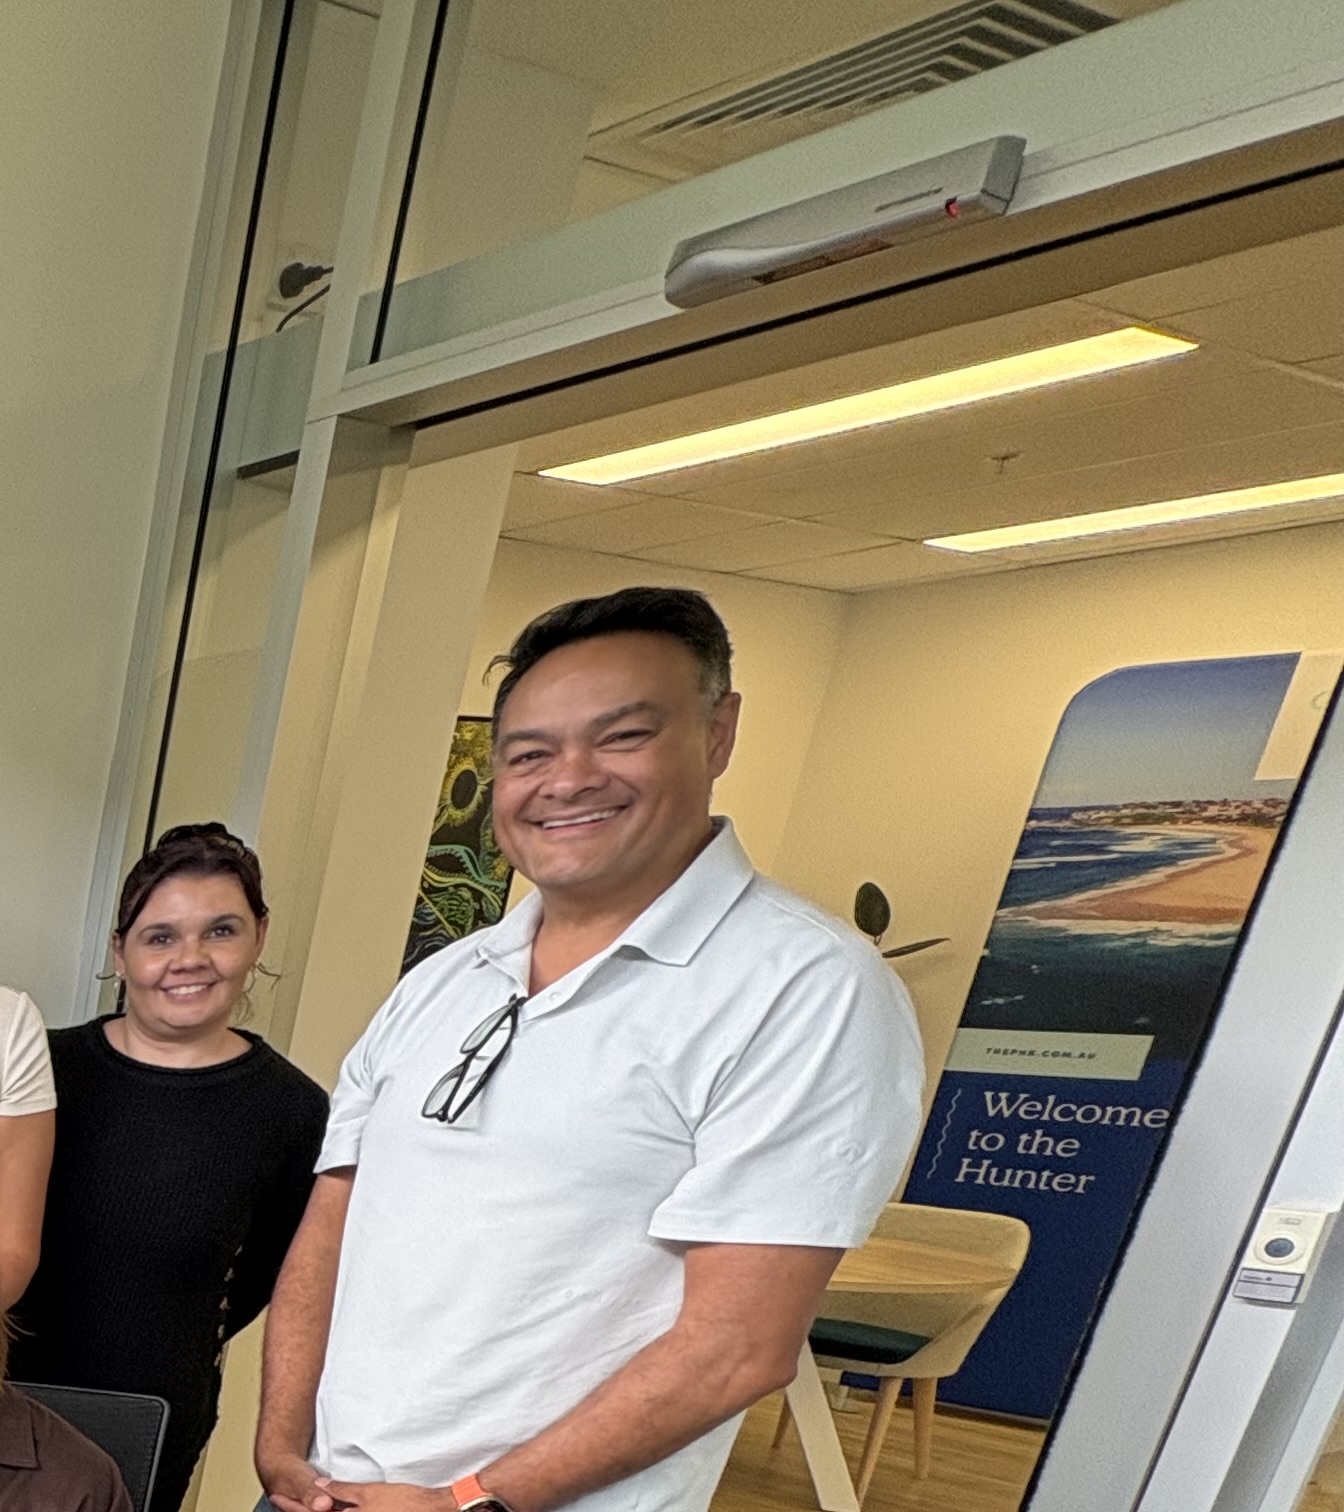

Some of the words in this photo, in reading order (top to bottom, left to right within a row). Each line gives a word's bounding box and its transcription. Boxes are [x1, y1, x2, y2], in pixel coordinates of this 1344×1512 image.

[983, 1090, 1171, 1130] Welcome
[968, 1129, 1005, 1152] to
[1017, 1129, 1081, 1158] the
[954, 1158, 1096, 1195] Hunter
